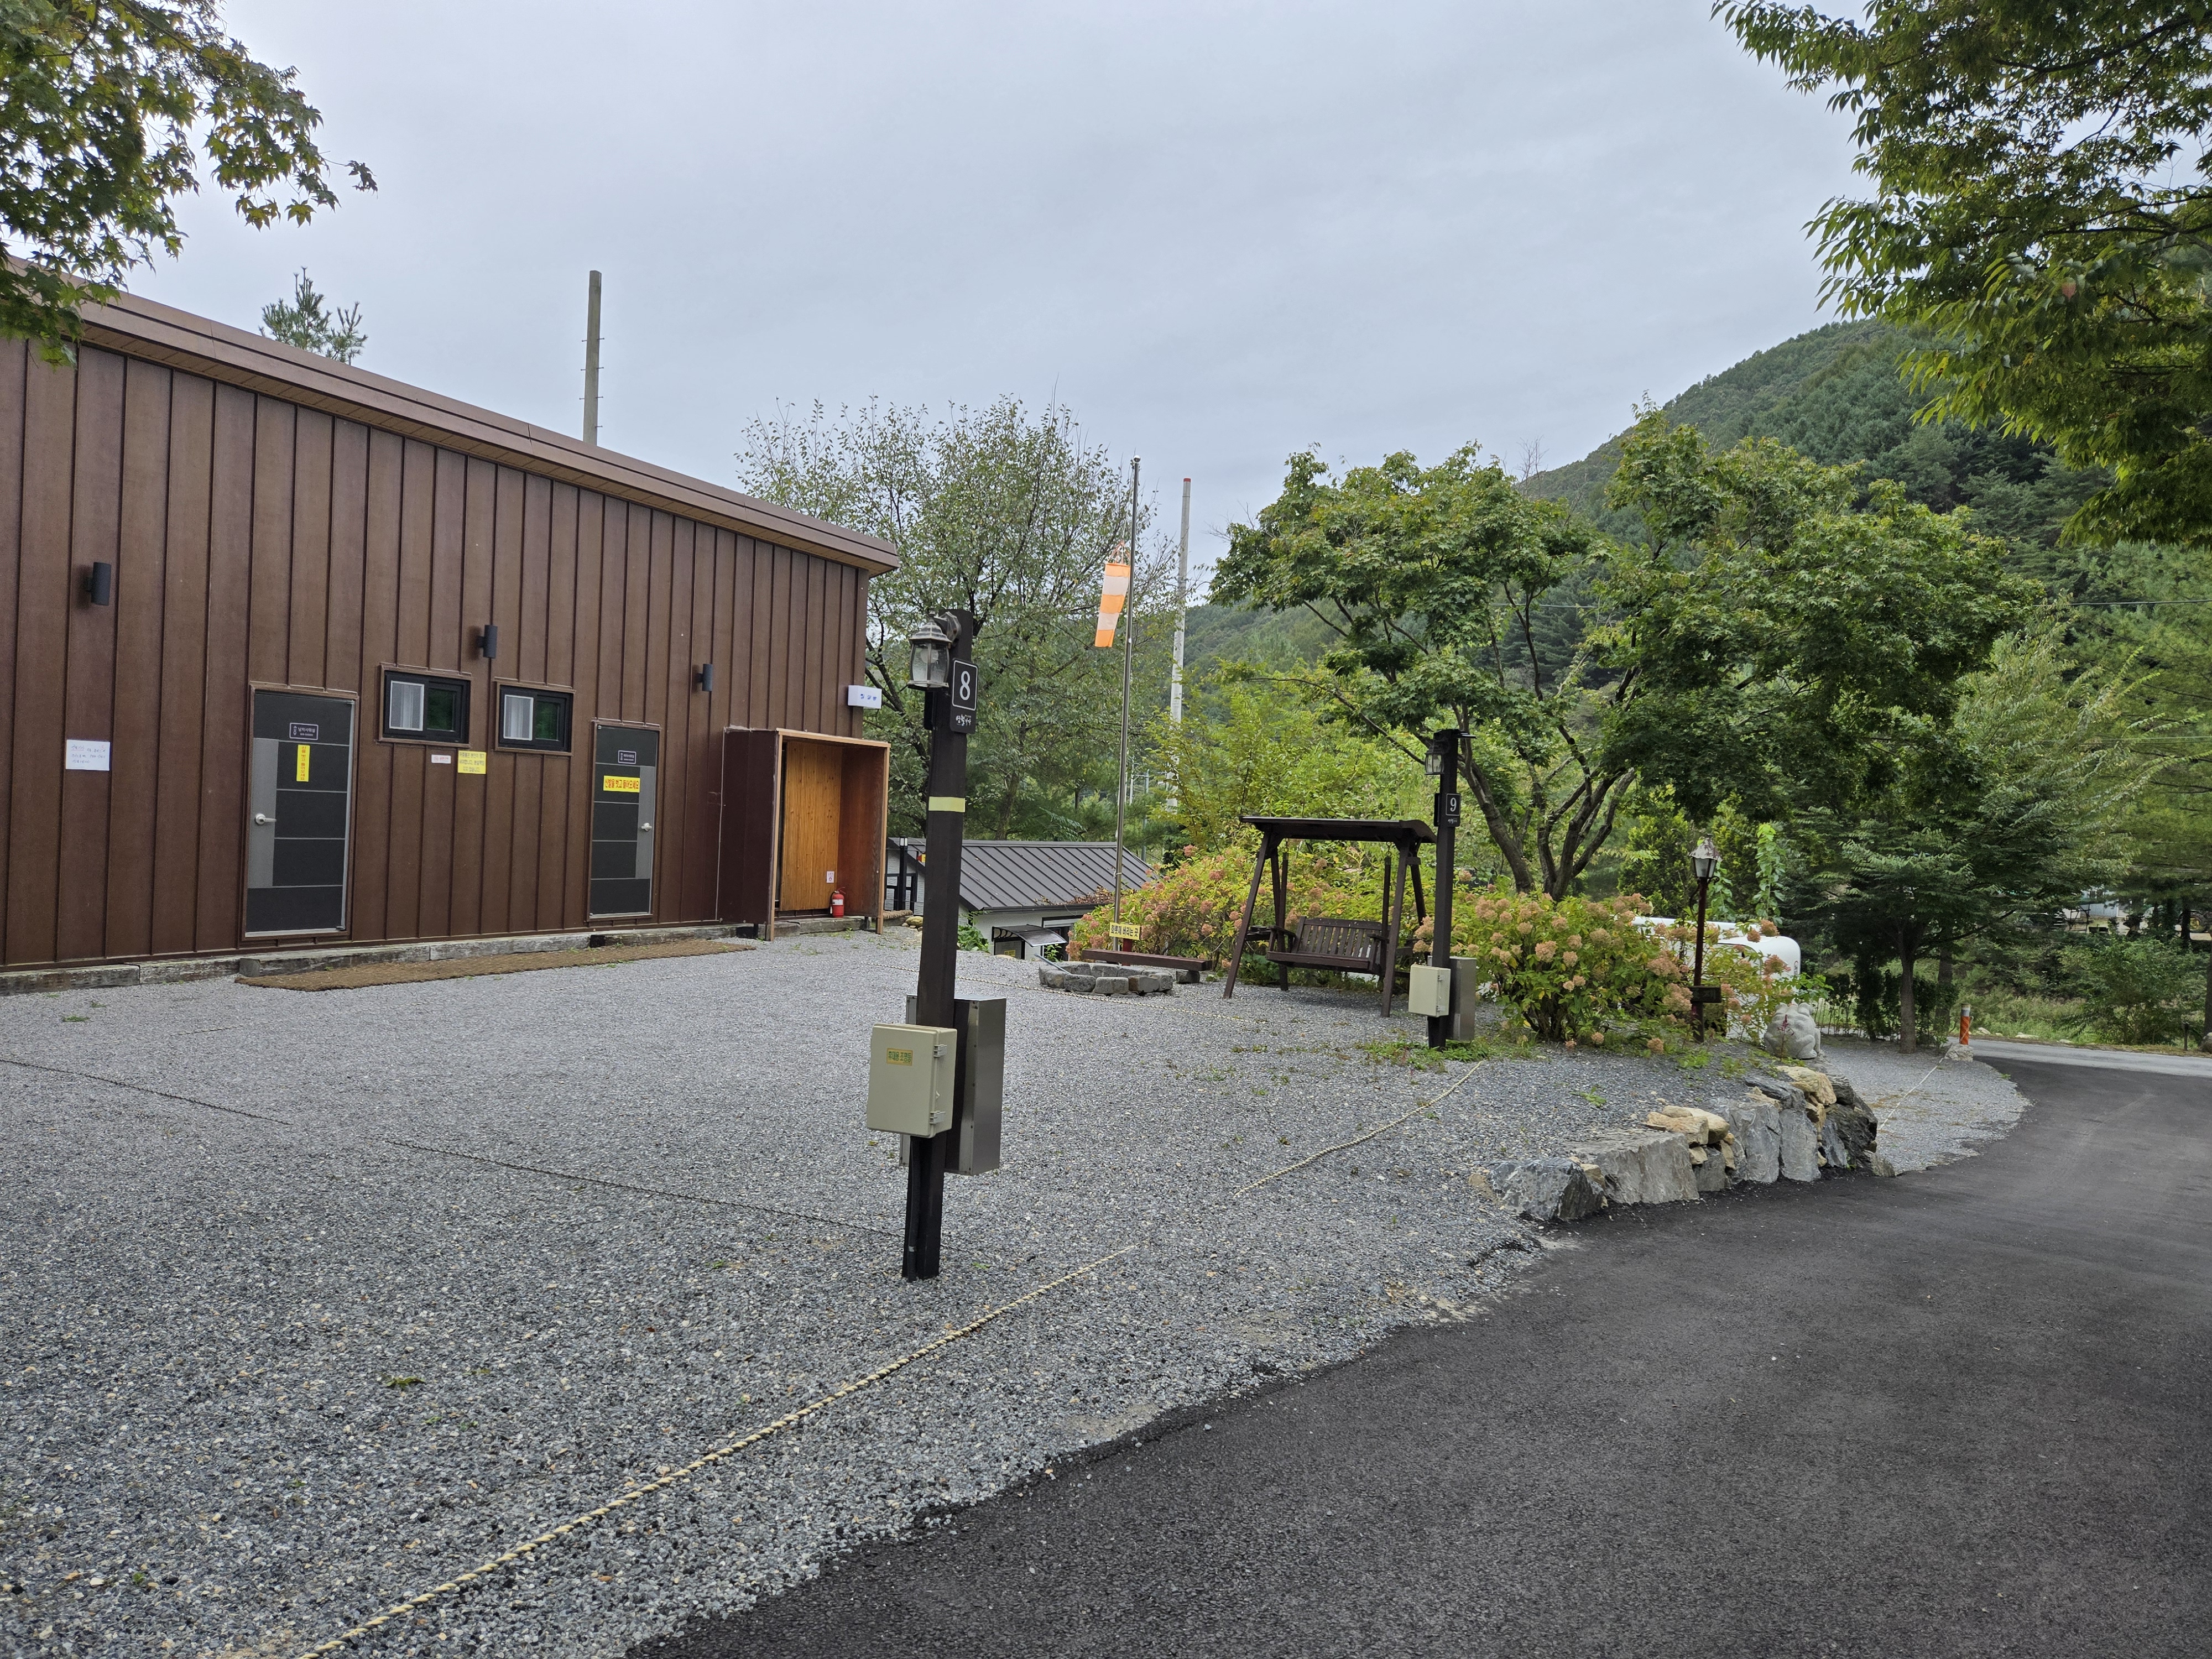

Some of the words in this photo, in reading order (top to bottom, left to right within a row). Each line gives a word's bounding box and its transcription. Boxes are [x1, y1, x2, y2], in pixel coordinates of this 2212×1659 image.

[959, 671, 971, 701] 8
[605, 779, 614, 788] 신발을
[615, 779, 622, 788] 벗고
[623, 780, 639, 789] 들어오세요
[1450, 797, 1457, 812] 9
[1123, 926, 1133, 936] 버리는
[1134, 928, 1139, 937] 곳
[888, 1051, 899, 1061] 휴대용
[900, 1052, 912, 1062] 조명등
